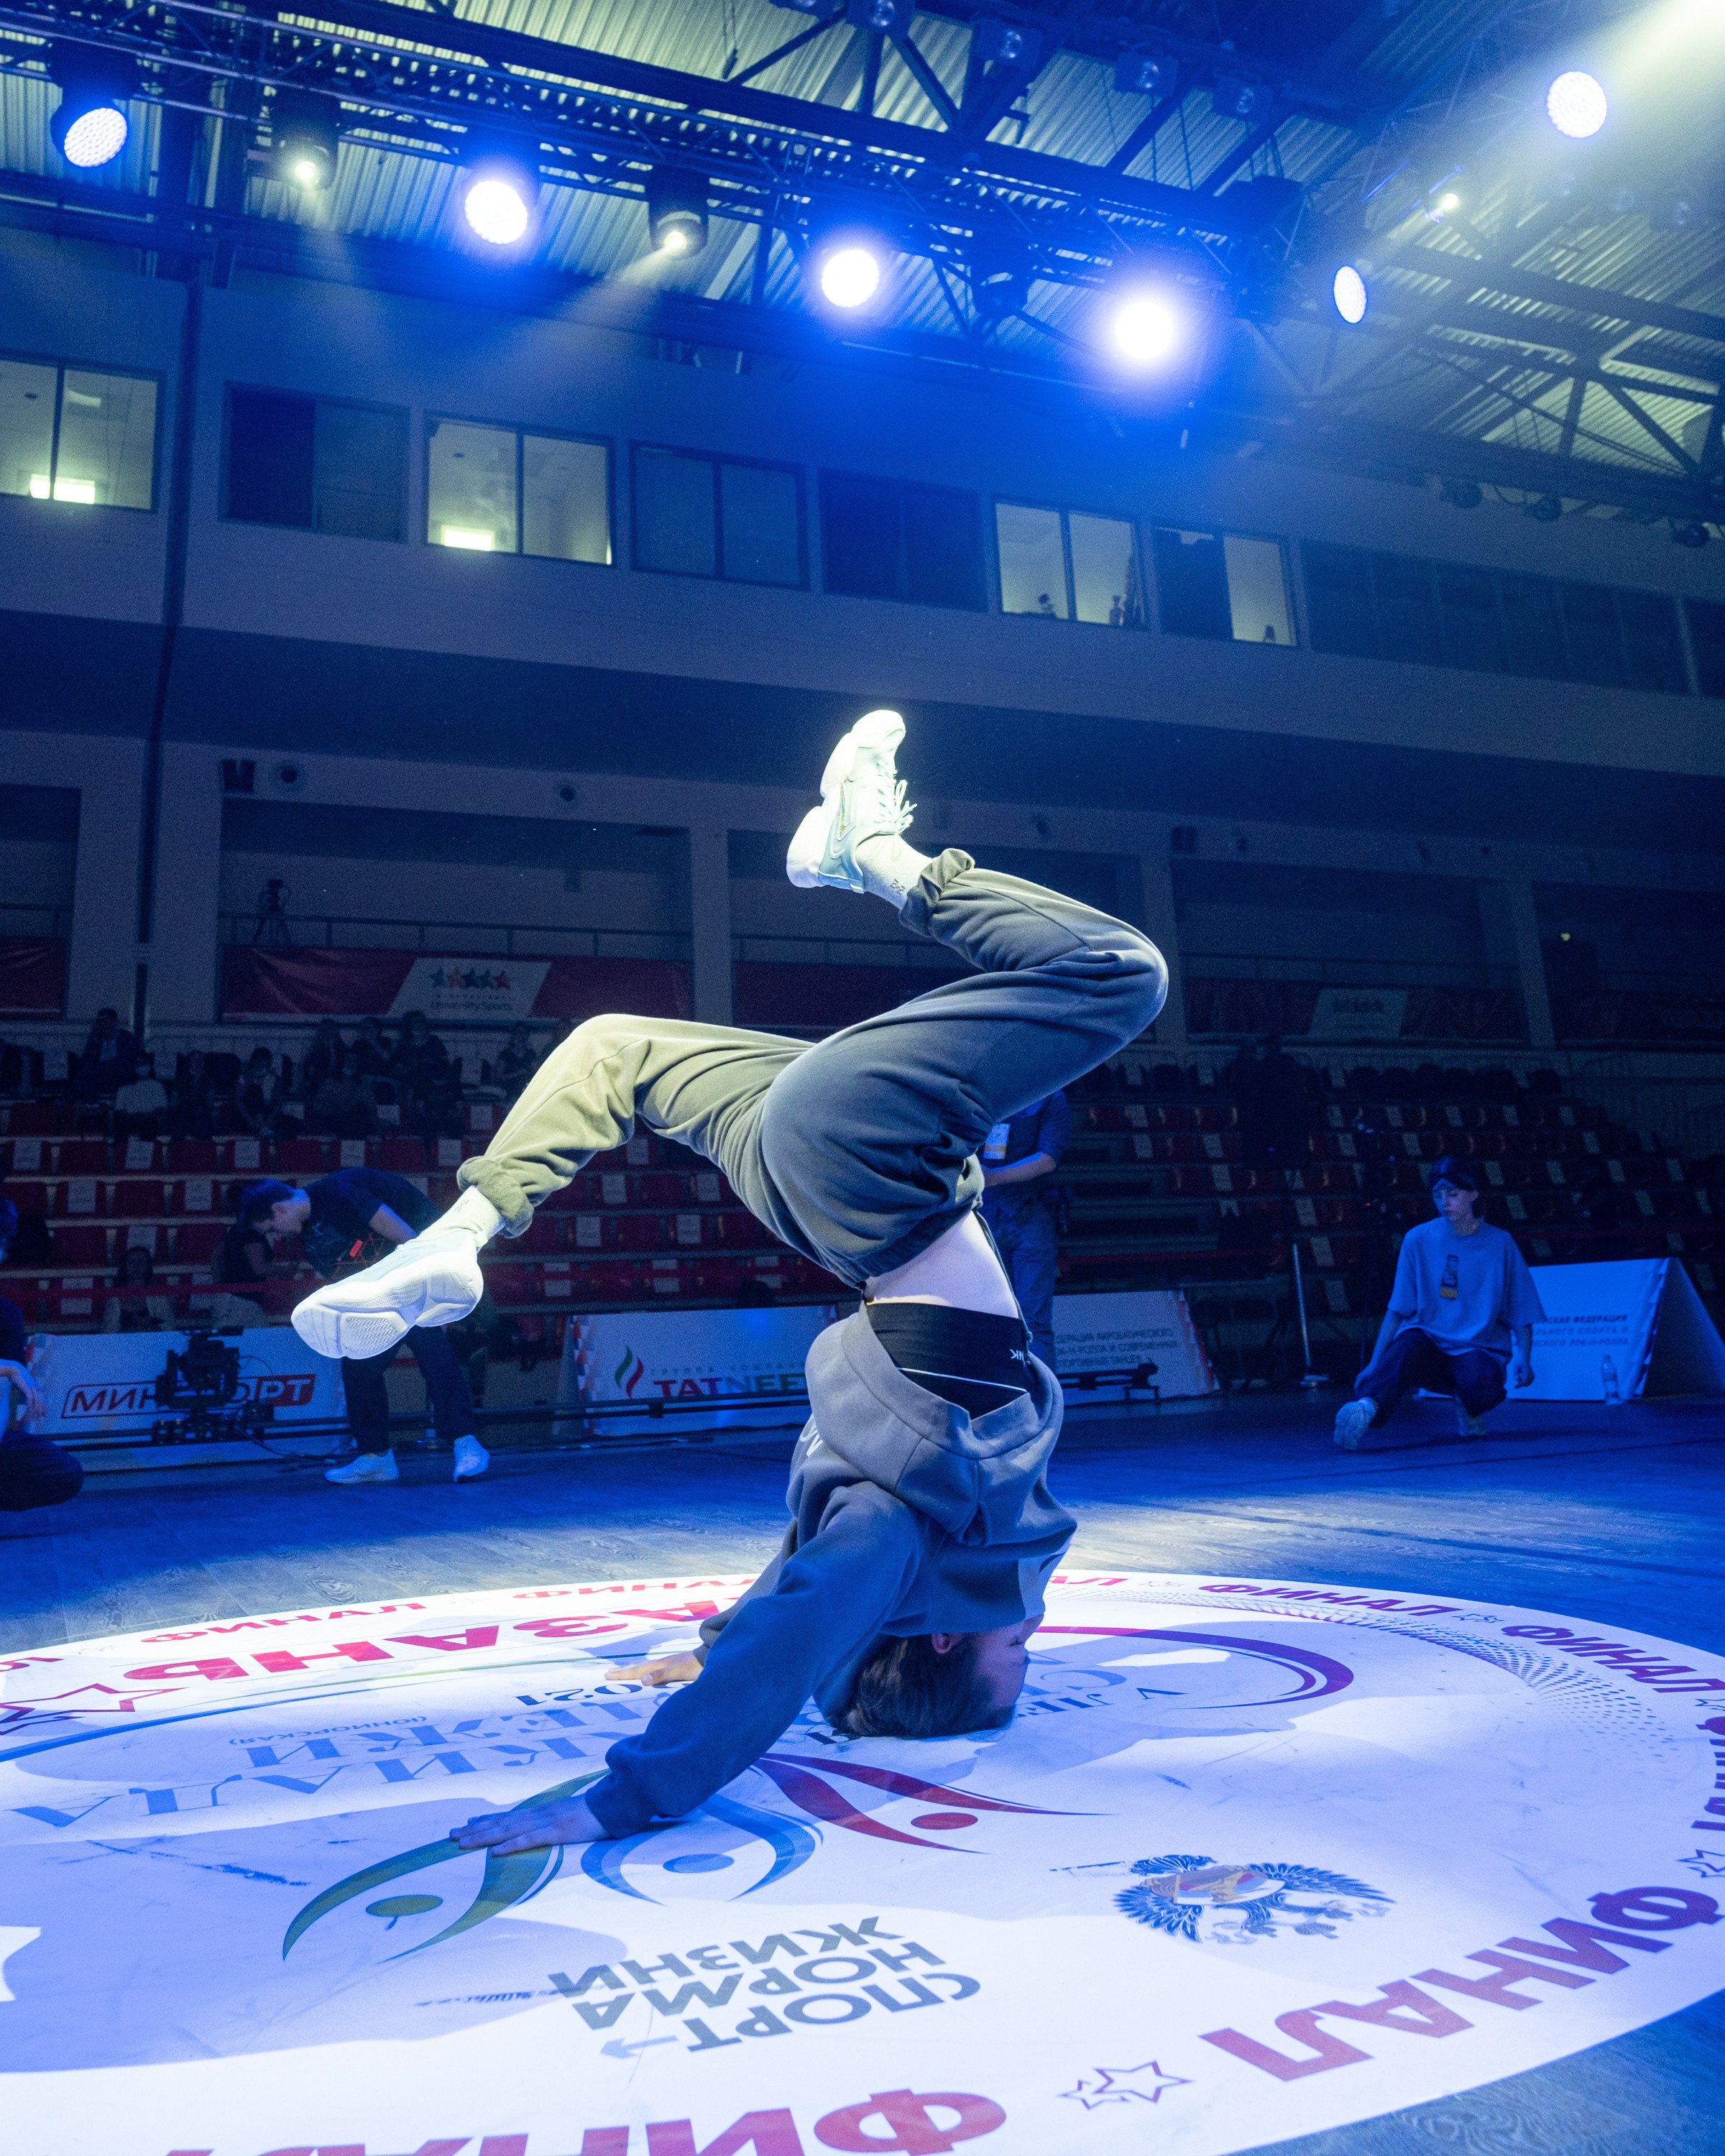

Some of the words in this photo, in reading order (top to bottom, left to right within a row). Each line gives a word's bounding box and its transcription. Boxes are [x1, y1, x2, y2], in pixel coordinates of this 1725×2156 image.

[653, 1373, 805, 1398] TATNEF
[141, 1603, 428, 1643] ФИНАЛ
[1197, 1584, 1463, 1616] ФИНАЛ
[123, 1596, 720, 1681] АЗАНЬ
[1501, 1625, 1725, 1693] ФИНАЛ
[229, 1715, 427, 1746] (ЮНИОРСКАЯ)
[547, 1916, 904, 1998] ЖИЗНИ
[571, 1941, 947, 2030] НОРМА
[1197, 1886, 1725, 2082] ФИНАЛ
[682, 1973, 980, 2053] СПОРТ
